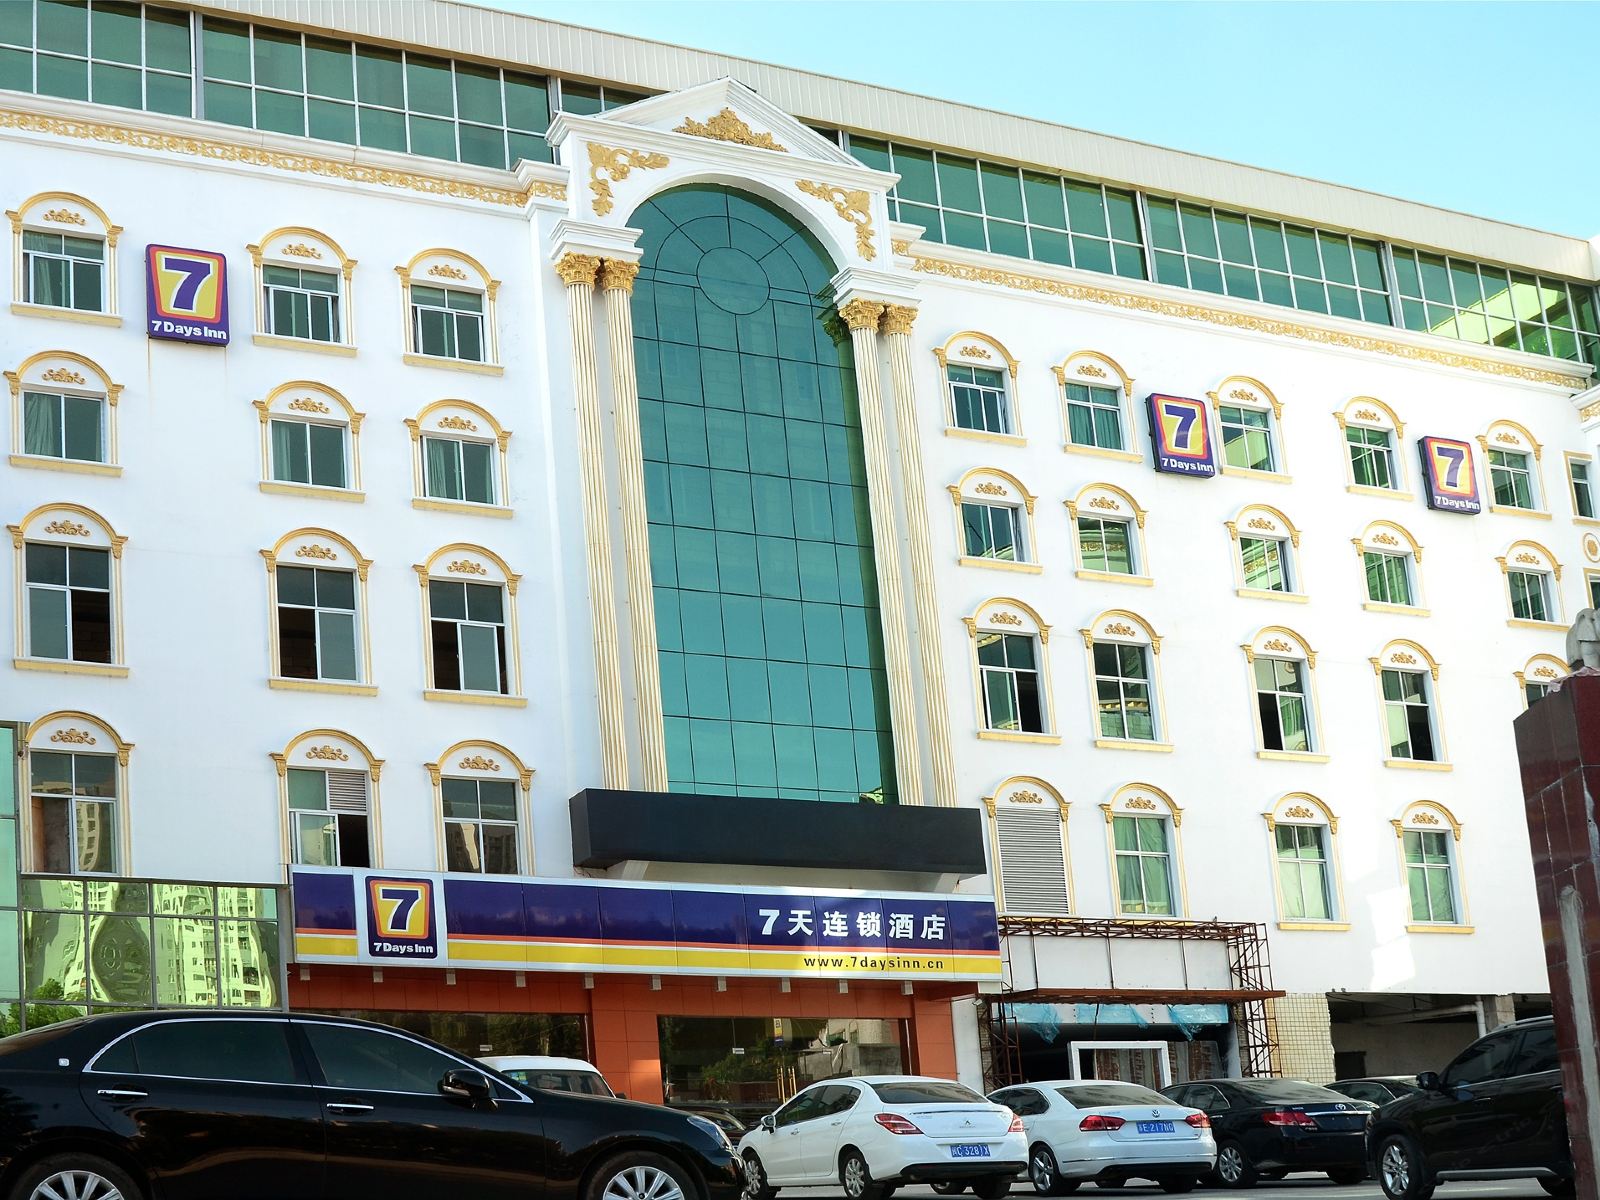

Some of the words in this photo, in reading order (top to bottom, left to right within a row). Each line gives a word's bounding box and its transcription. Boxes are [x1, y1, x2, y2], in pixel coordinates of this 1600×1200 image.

[161, 254, 213, 313] 7
[151, 320, 162, 332] 7
[163, 321, 202, 337] Days
[203, 326, 227, 340] Inn
[1163, 402, 1198, 450] 7
[1161, 457, 1170, 467] 7
[1170, 458, 1197, 471] Days
[1197, 462, 1214, 473] Inn
[1435, 445, 1465, 489] 7
[1434, 495, 1442, 505] 7
[1442, 496, 1466, 509] Days
[1466, 499, 1480, 510] Inn
[379, 886, 421, 933] 7
[373, 942, 382, 952] 7
[383, 942, 414, 954] Days
[414, 943, 434, 953] Inn
[803, 956, 945, 971] www.7daysinn.cn
